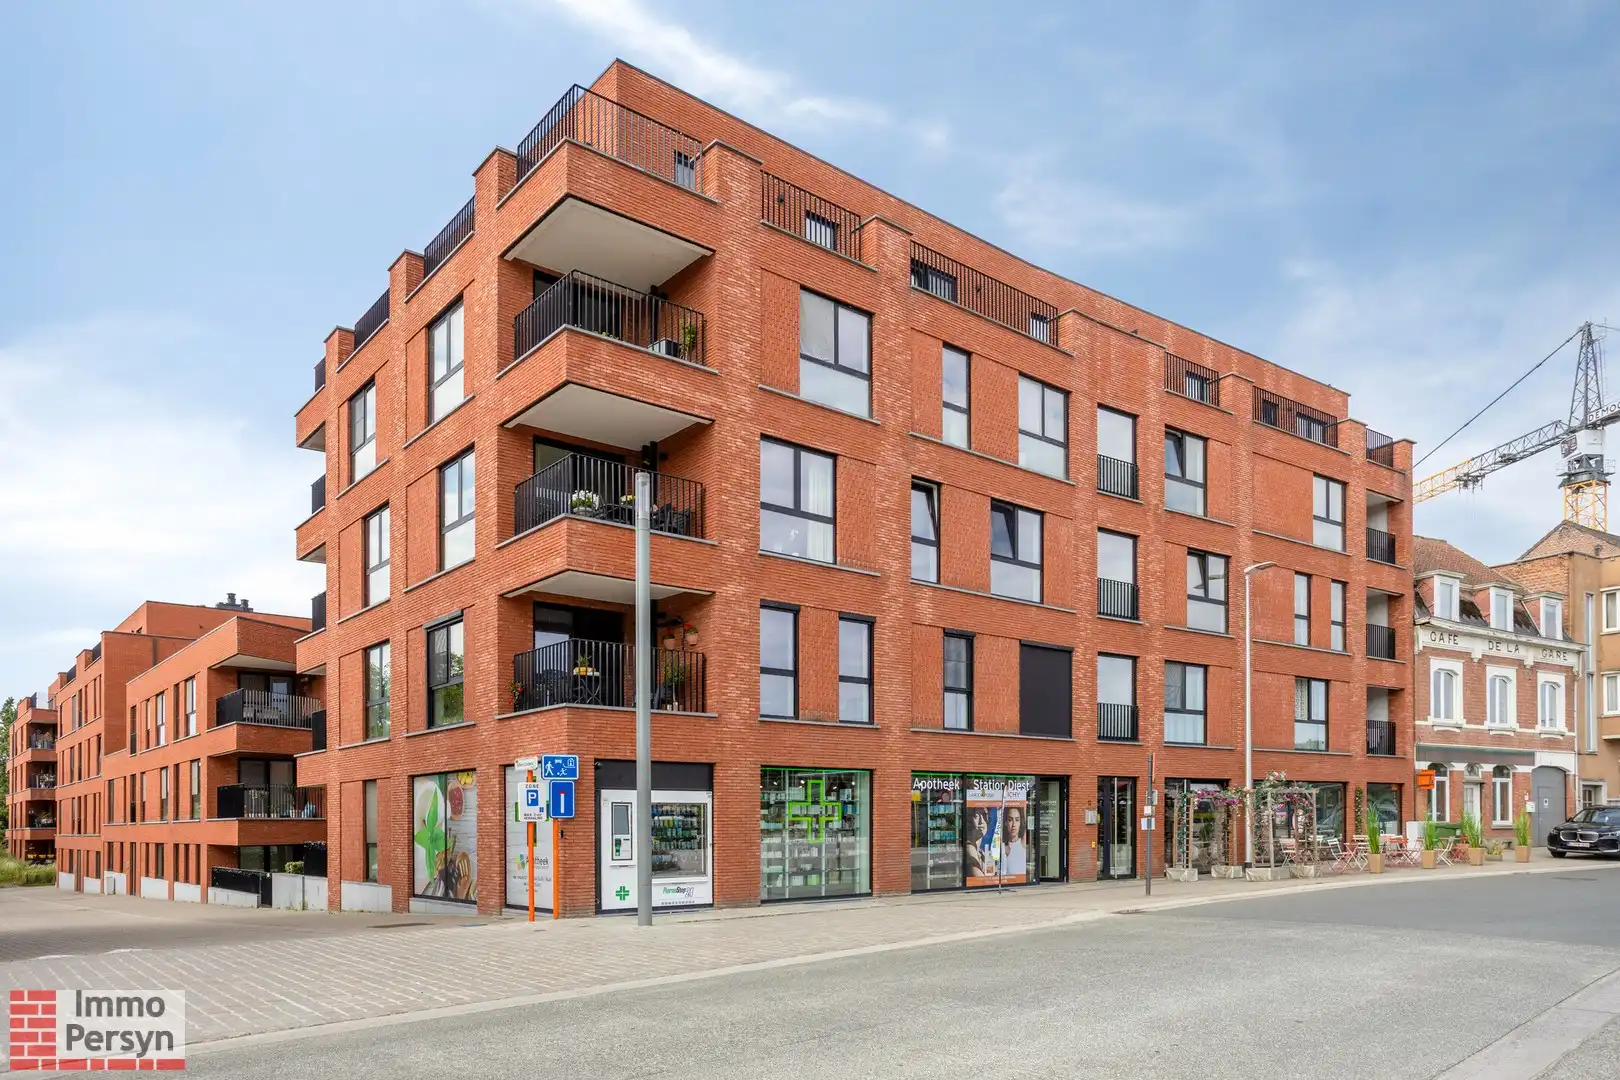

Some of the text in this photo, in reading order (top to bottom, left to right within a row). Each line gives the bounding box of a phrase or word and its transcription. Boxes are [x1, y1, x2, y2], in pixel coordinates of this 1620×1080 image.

[1488, 640, 1501, 650] DE
[1507, 643, 1520, 654] LA
[1541, 648, 1568, 661] GARE
[913, 778, 1030, 791] Apotheek Station Diest
